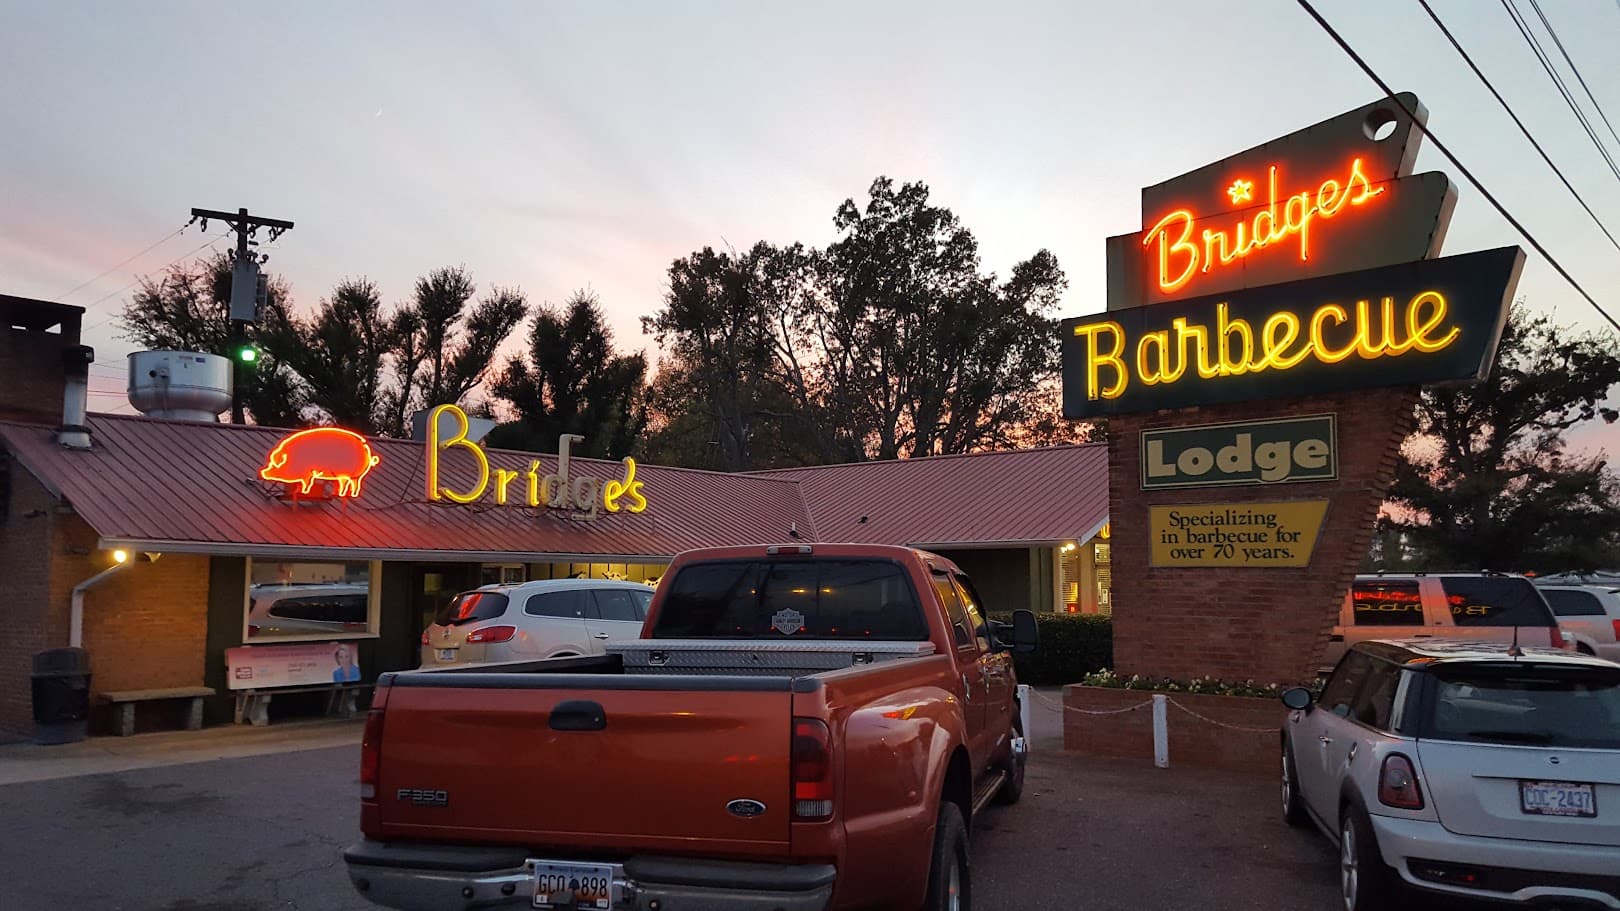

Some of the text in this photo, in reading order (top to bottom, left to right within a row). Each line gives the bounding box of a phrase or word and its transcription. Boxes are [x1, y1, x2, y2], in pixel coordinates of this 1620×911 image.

[1142, 157, 1385, 290] Bridges
[1074, 291, 1461, 401] Barbecue
[1147, 433, 1330, 482] Lodge
[1169, 510, 1278, 528] Specializing
[1161, 525, 1302, 544] in barbecue for
[1170, 543, 1295, 562] over 70 years.
[581, 876, 608, 898] 898
